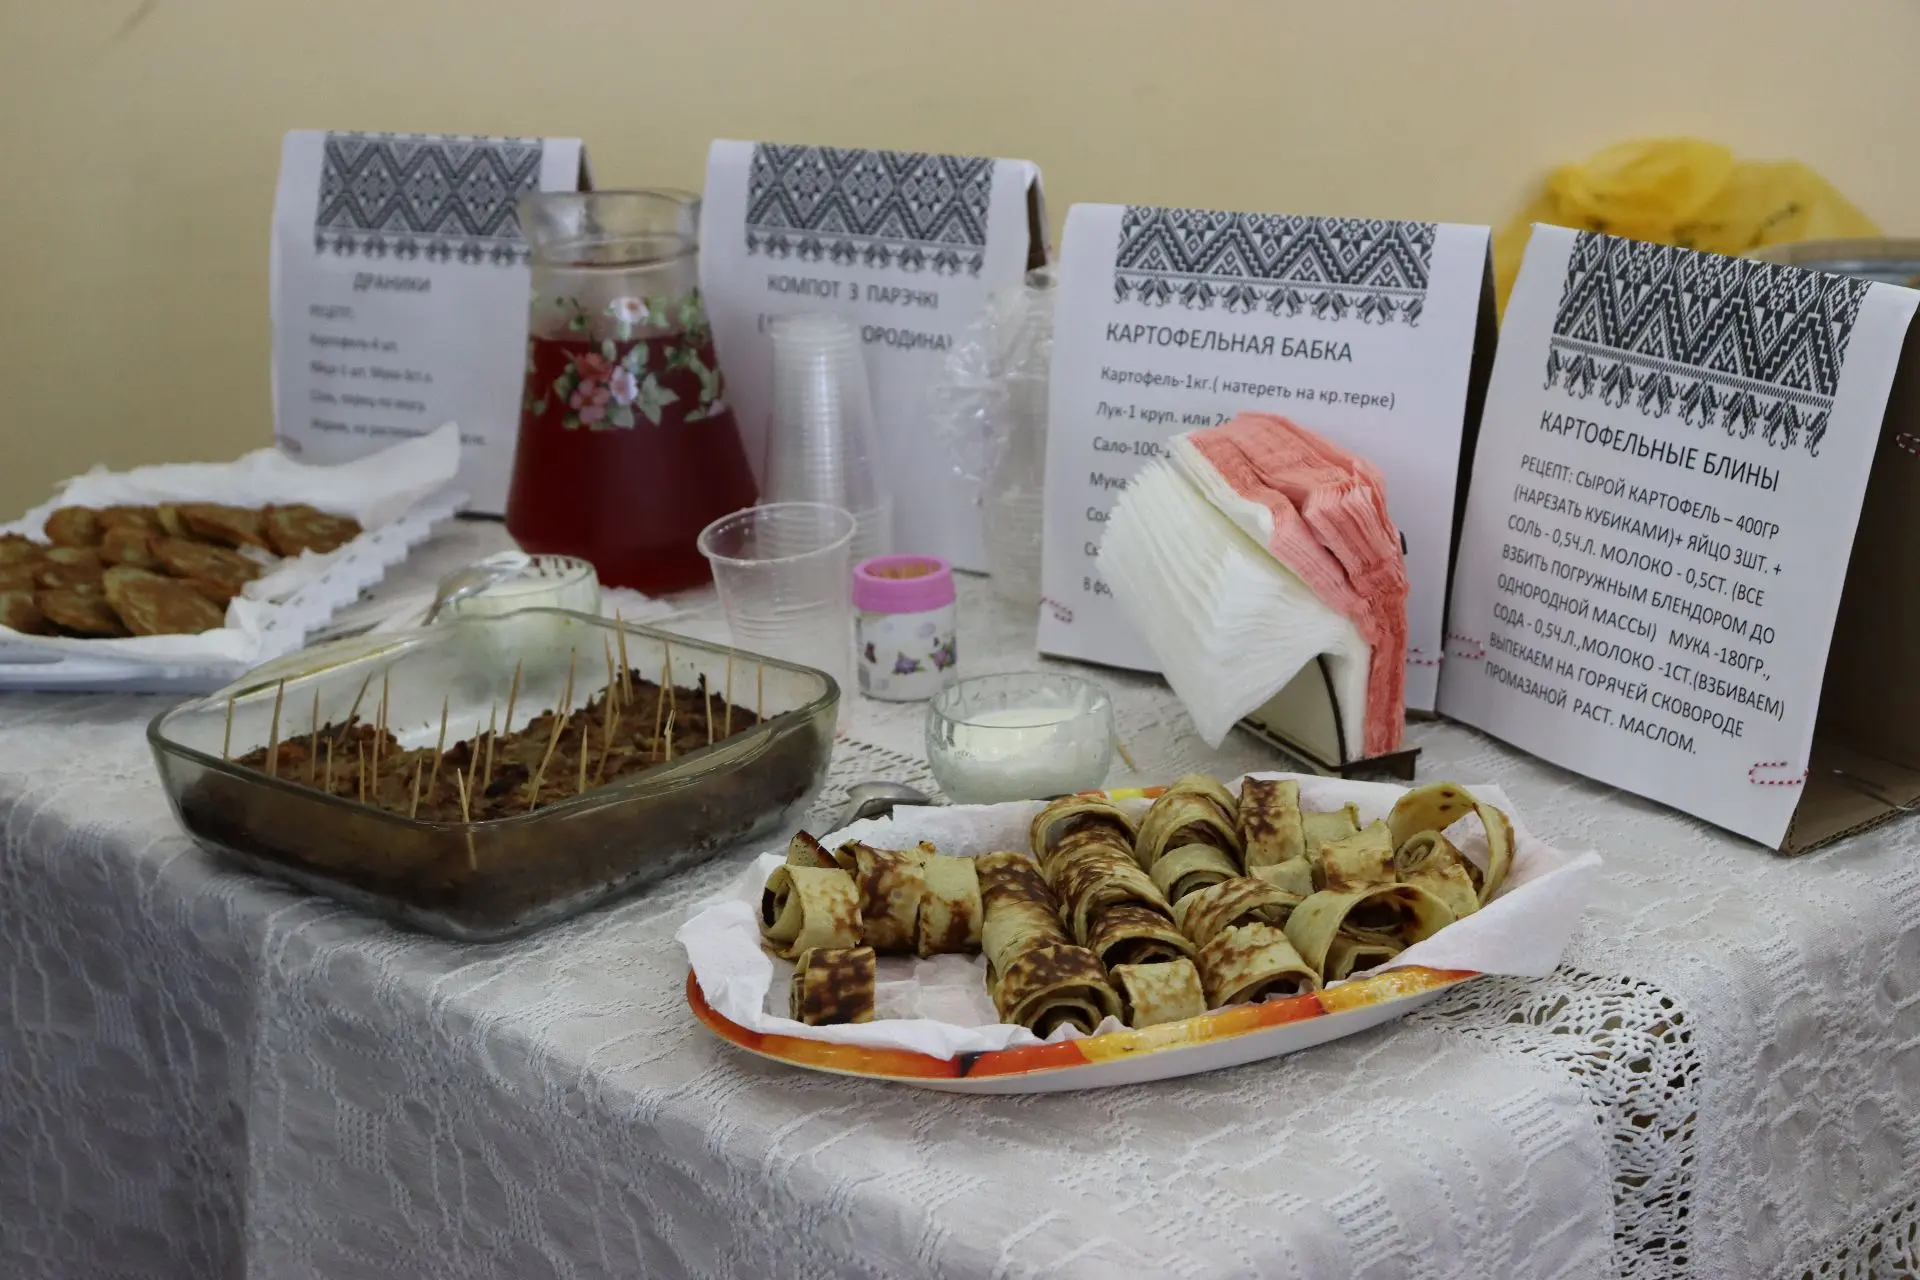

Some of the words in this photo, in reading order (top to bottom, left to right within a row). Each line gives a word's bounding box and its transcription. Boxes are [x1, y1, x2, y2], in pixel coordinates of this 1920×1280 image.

[767, 274, 842, 298] КОМПОТ
[1105, 322, 1275, 356] КАРТОФЕЛЬНАЯ
[1281, 336, 1353, 362] БАБКА
[1096, 401, 1136, 422] Лук-1
[1140, 409, 1178, 424] круп.
[1182, 414, 1210, 427] или
[1222, 376, 1293, 399] натереть
[1296, 387, 1315, 401] на
[1319, 389, 1396, 410] кр.терке)
[1540, 409, 1699, 470] КАРТОФЕЛЬНЫЕ
[1703, 451, 1780, 492] БЛИНЫ
[1513, 483, 1582, 518] (НАРЕЗАТЬ
[1584, 505, 1683, 548] КУБИКАМИ)+
[1686, 533, 1732, 562] ЯЙЦО
[1733, 547, 1768, 574] 3ШТ.
[1773, 563, 1782, 576] +
[1520, 454, 1573, 484] РЕЦЕПТ:
[1575, 469, 1626, 499] СЫРОЙ
[1628, 485, 1721, 524] КАРТОФЕЛЬ
[1735, 514, 1780, 540] 400ГР
[1502, 543, 1549, 572] ВЗБИТЬ
[1550, 559, 1648, 604] ПОГРУЖНЫМ
[1651, 591, 1748, 636] БЛЕНДОРОМ
[1748, 623, 1776, 645] ДО
[1507, 513, 1542, 538] СОЛЬ
[1599, 543, 1673, 577] МОЛОКО
[1685, 567, 1728, 596] 0,5СТ.
[1731, 580, 1765, 607] (ВСЕ
[1493, 601, 1525, 629] СОДА
[1497, 572, 1590, 619] ОДНОРОДНОЙ
[1591, 605, 1657, 643] МАССЫ)
[1668, 629, 1710, 659] МУКА
[1713, 647, 1771, 681] -180ГР.,
[1484, 660, 1568, 709] ПРОМАЗАНОЙ
[1572, 697, 1614, 727] РАСТ.
[1618, 713, 1696, 755] МАСЛОМ.
[1489, 631, 1554, 671] ВЫПЕКАЕМ
[1555, 658, 1574, 680] НА
[1577, 666, 1648, 704] ГОРЯЧЕЙ
[1651, 691, 1744, 738] СКОВОРОДЕ
